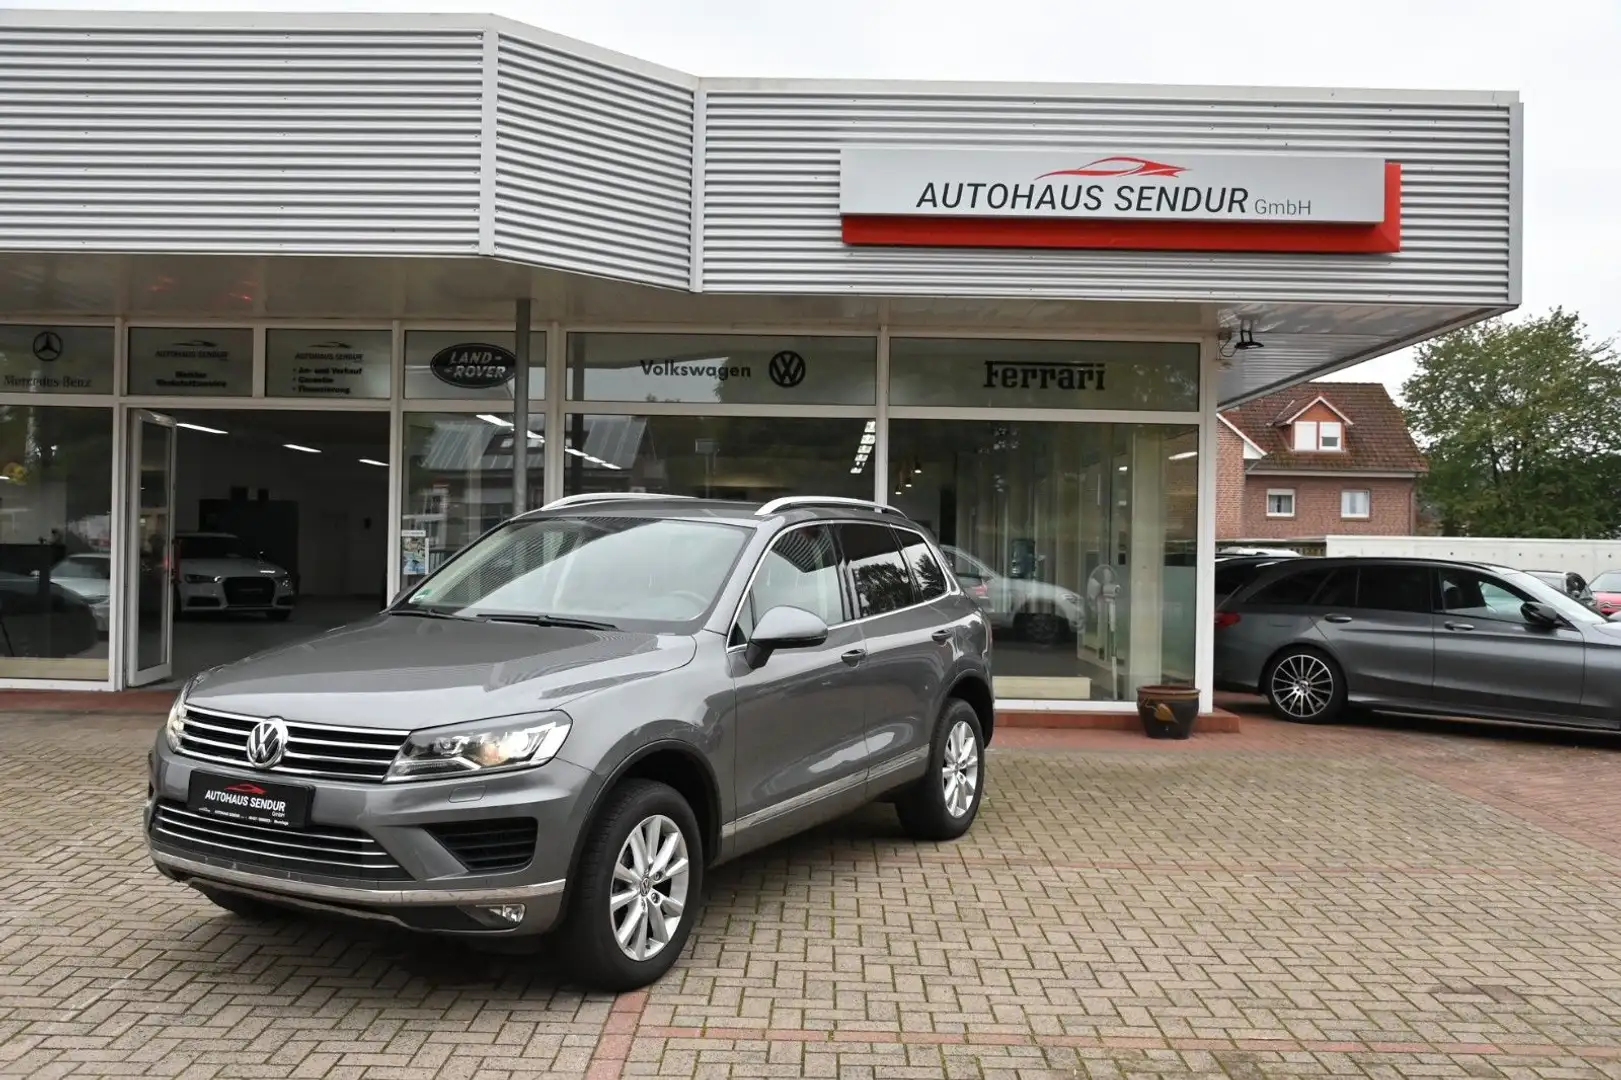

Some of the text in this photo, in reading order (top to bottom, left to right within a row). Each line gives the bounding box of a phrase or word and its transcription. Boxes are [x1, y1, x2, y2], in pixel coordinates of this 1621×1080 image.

[915, 181, 1312, 216] AUTOHAUS SENDUR GmbH
[640, 359, 751, 381] Volkswagen
[983, 360, 1106, 391] Ferrari
[205, 789, 286, 812] AUTOHAUS SENDUR
